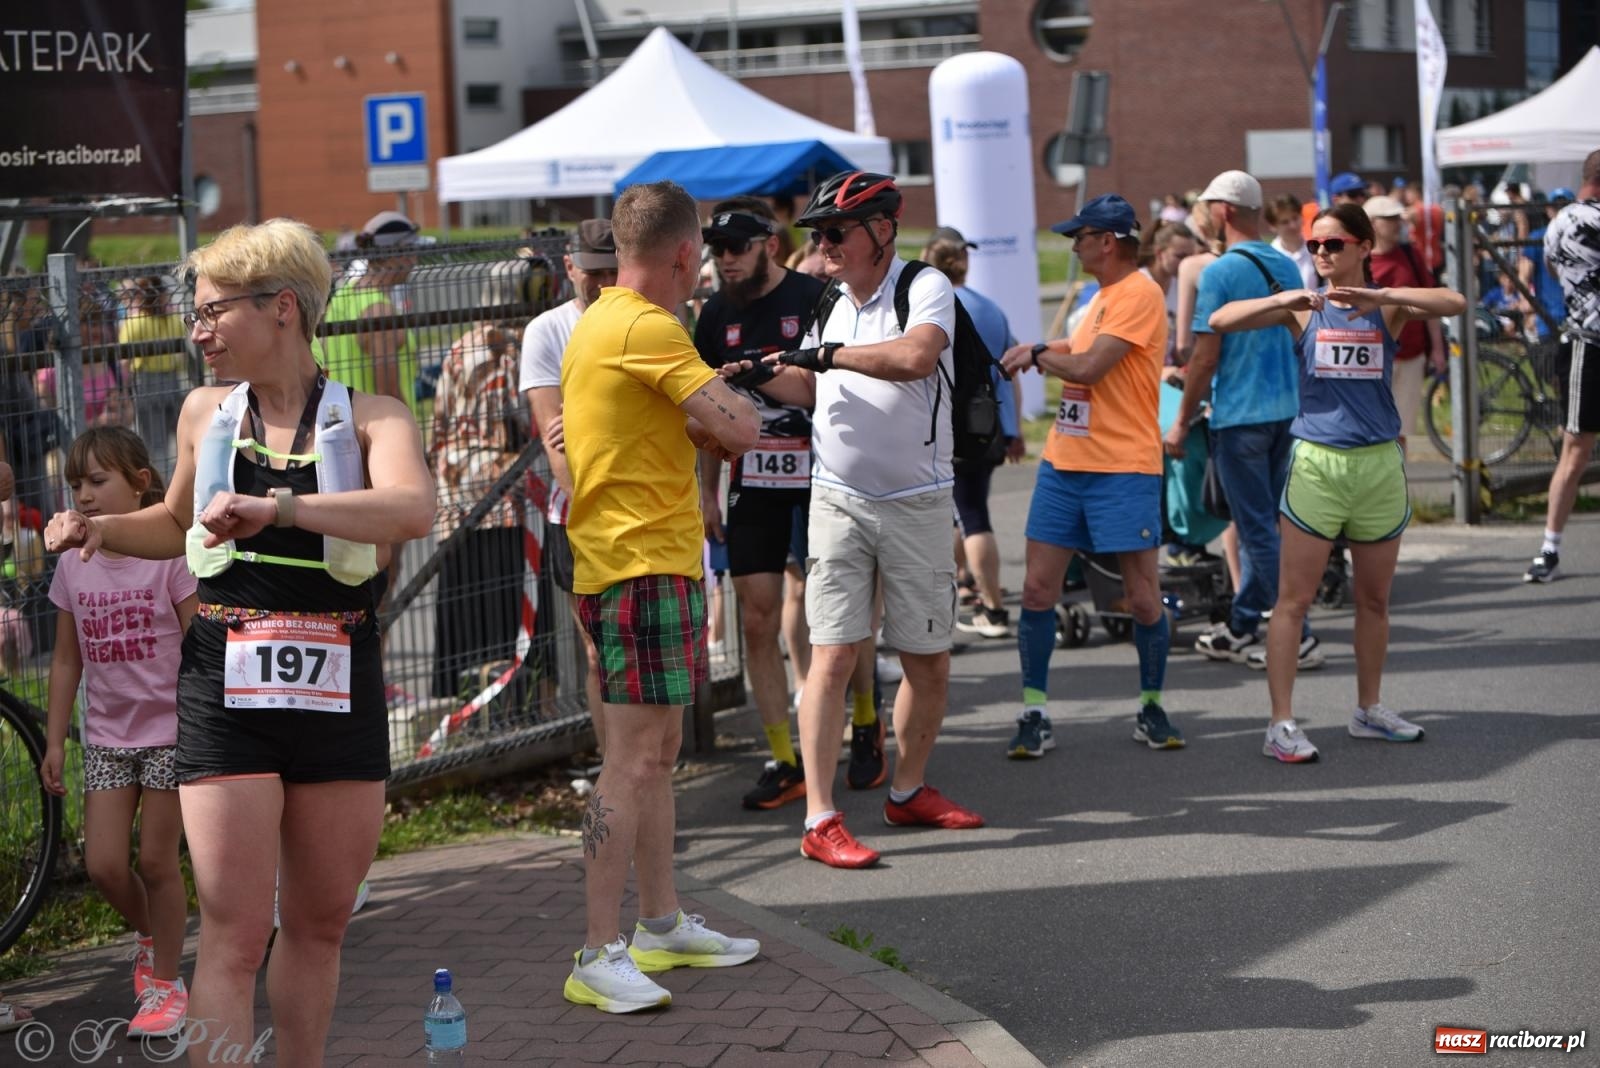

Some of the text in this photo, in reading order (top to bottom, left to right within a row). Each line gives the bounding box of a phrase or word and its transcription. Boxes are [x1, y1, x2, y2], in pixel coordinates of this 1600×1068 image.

[377, 102, 415, 159] P
[0, 144, 141, 167] osir-raciborz.pl
[1332, 345, 1370, 366] 176
[755, 453, 797, 474] 148
[78, 589, 154, 608] PARENTS
[82, 605, 154, 640] SWEET
[244, 619, 337, 631] XVI BIEG BEZ GRANIC
[256, 645, 327, 685] 197
